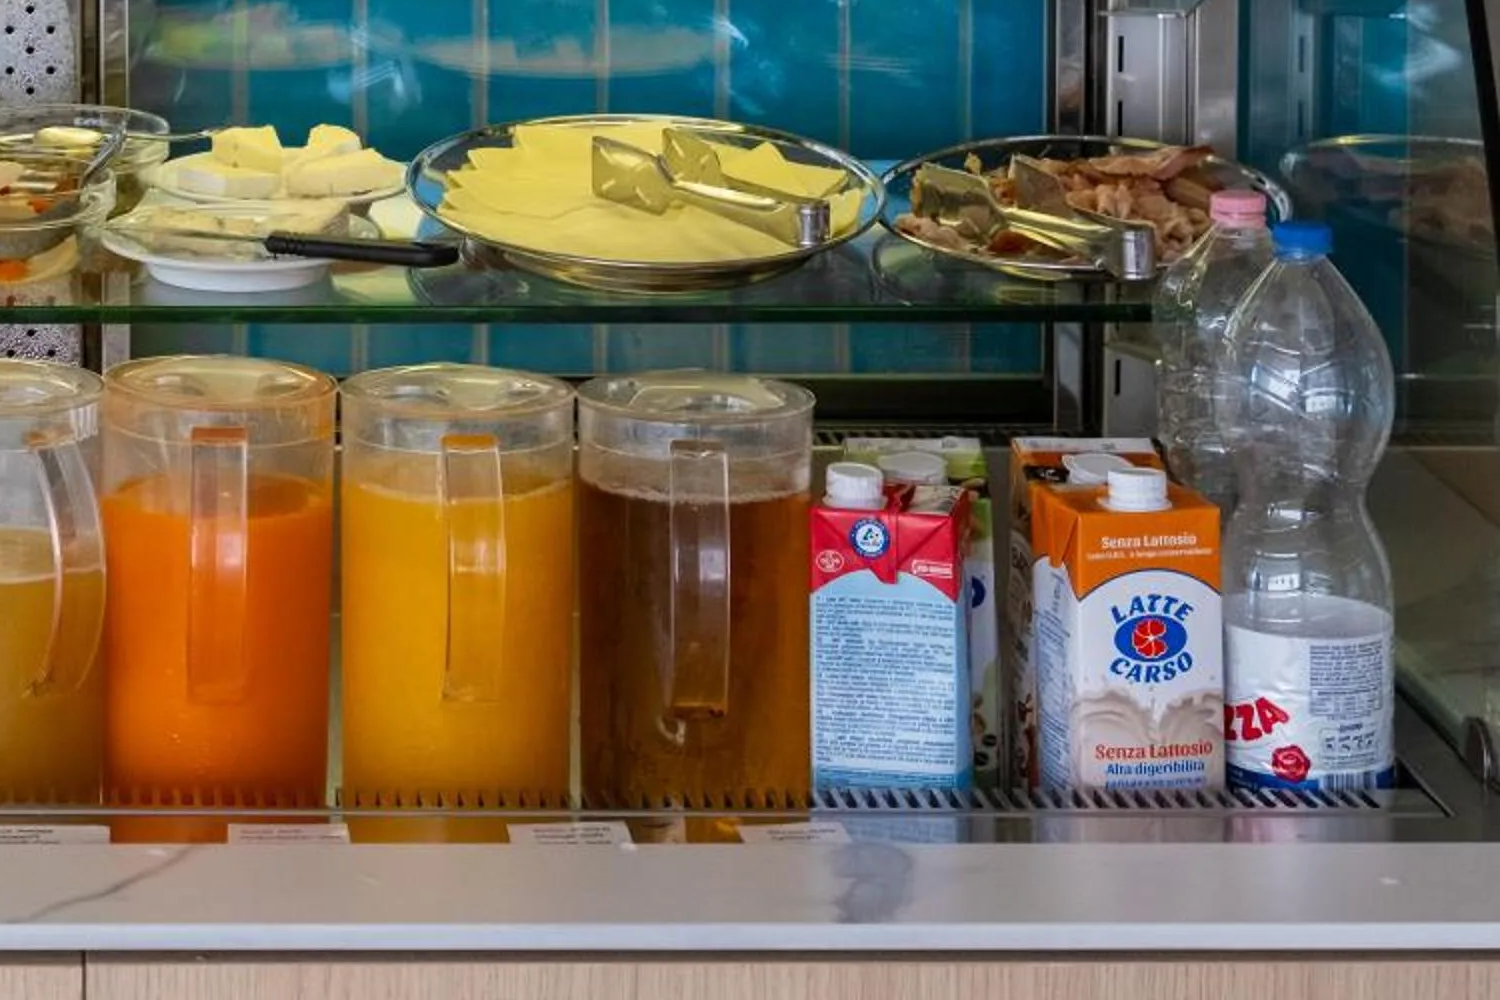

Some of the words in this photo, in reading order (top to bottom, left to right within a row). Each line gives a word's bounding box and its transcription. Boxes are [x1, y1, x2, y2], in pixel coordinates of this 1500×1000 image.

[1101, 536, 1140, 549] Senza
[1143, 531, 1197, 547] Lattosio
[1111, 594, 1194, 624] LATTE
[1110, 651, 1192, 683] CARSO
[1095, 744, 1146, 759] Senza
[1149, 740, 1213, 758] Lattosio
[1107, 763, 1133, 775] Alta
